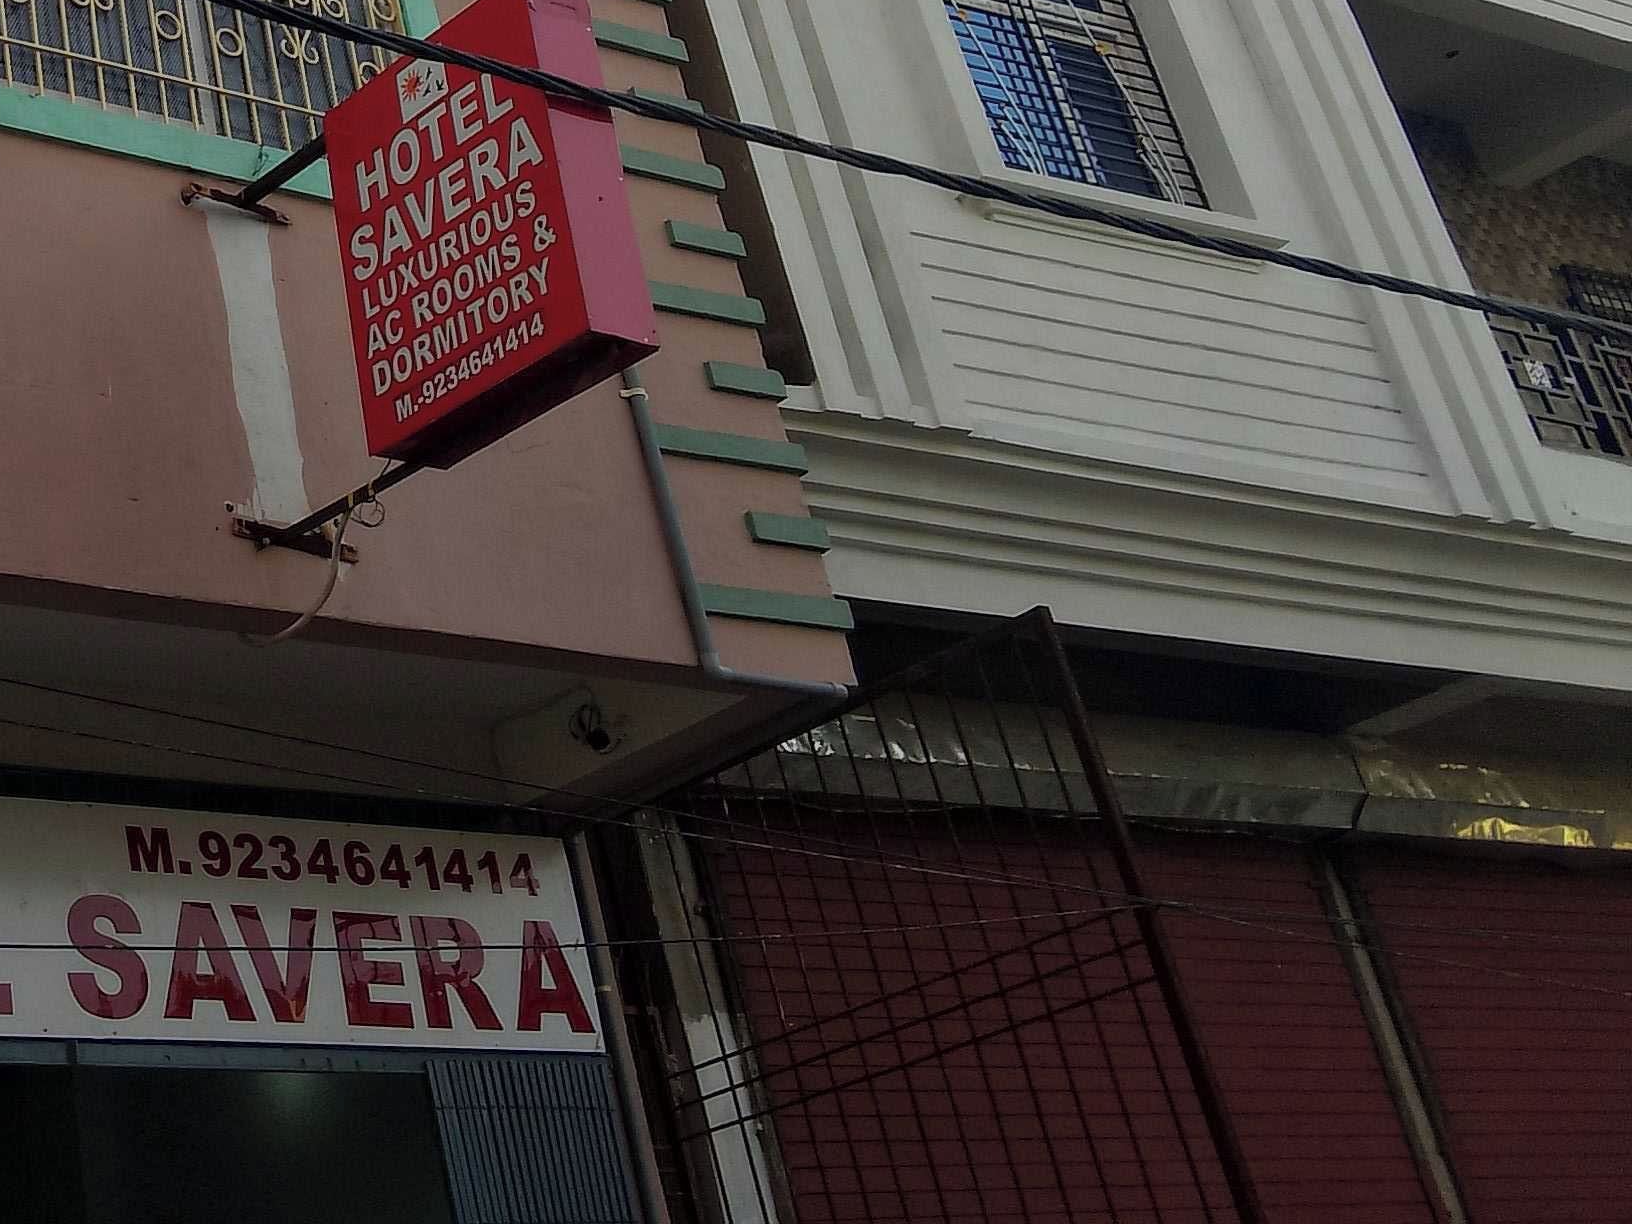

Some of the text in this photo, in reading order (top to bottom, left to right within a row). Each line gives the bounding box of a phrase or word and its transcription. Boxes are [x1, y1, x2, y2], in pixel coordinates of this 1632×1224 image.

[351, 117, 543, 281] SAVERA
[355, 73, 514, 213] HOTEL
[362, 180, 536, 319] LUXURIOUS
[367, 214, 557, 359] AC ROOMS &
[372, 256, 550, 396] DORMITORY
[125, 825, 540, 896] M.9234641414
[66, 892, 597, 1034] SAVERA
